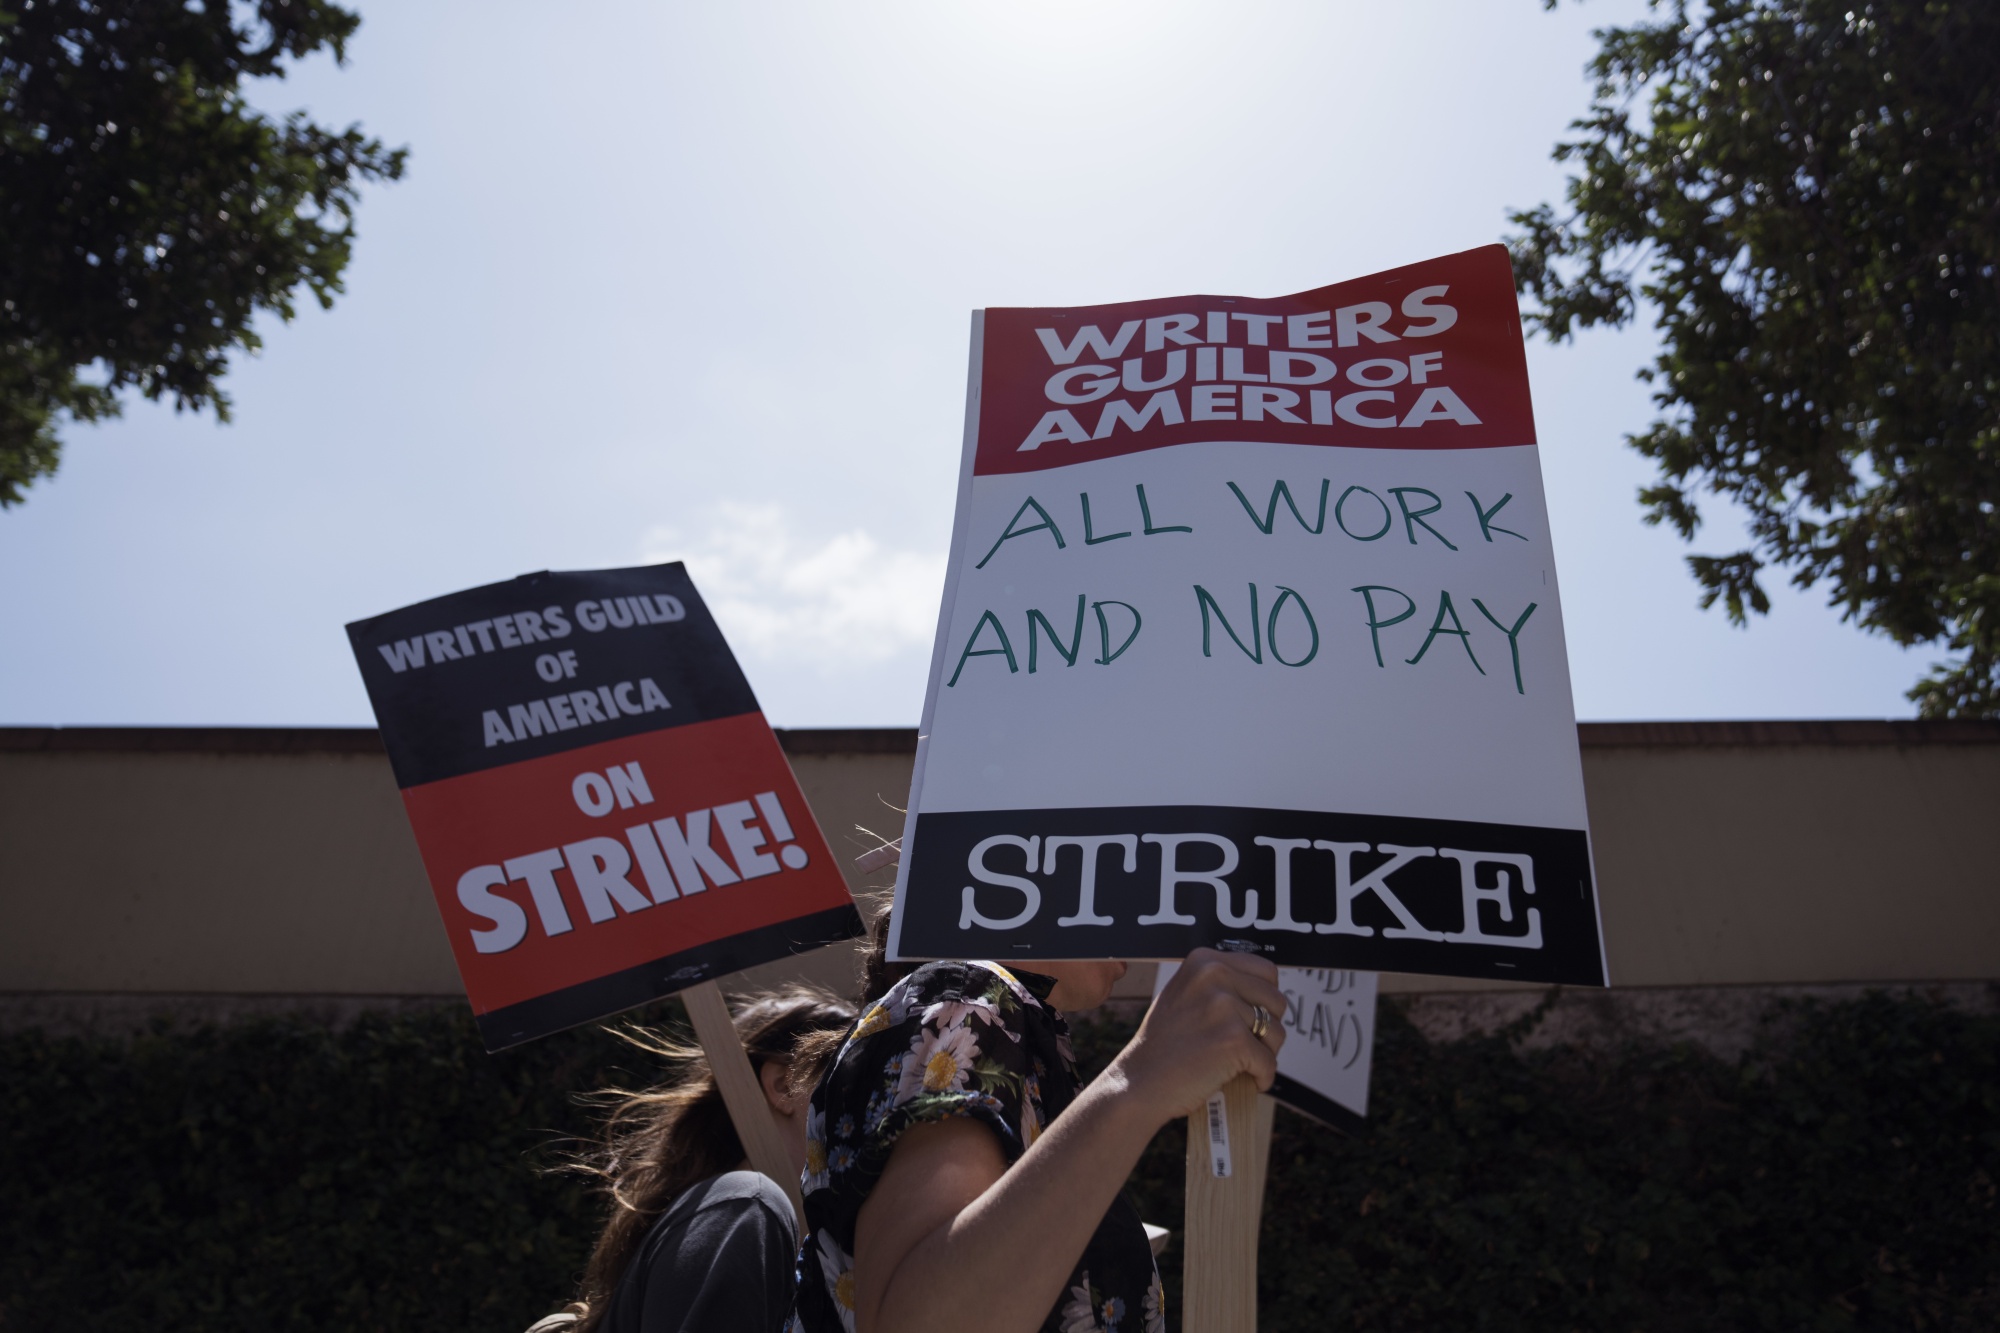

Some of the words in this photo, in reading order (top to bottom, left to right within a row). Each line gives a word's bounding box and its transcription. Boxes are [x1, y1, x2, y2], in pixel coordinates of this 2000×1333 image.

[1034, 284, 1459, 365] WRITERS
[1043, 346, 1338, 405] GUILD
[1346, 350, 1443, 387] OF
[1015, 384, 1484, 452] AMERICA
[975, 483, 1193, 570] ALL
[1226, 478, 1529, 552] WORK
[377, 605, 572, 674] WRITERS
[575, 593, 686, 634] GUILD
[535, 649, 578, 684] OF
[947, 594, 1142, 688] AND
[1193, 582, 1320, 668] NO
[1351, 584, 1539, 695] PAY
[481, 677, 672, 749] AMERICA
[571, 761, 655, 818] ON
[456, 790, 810, 955] STRIKE!
[958, 832, 1544, 950] STRIKE
